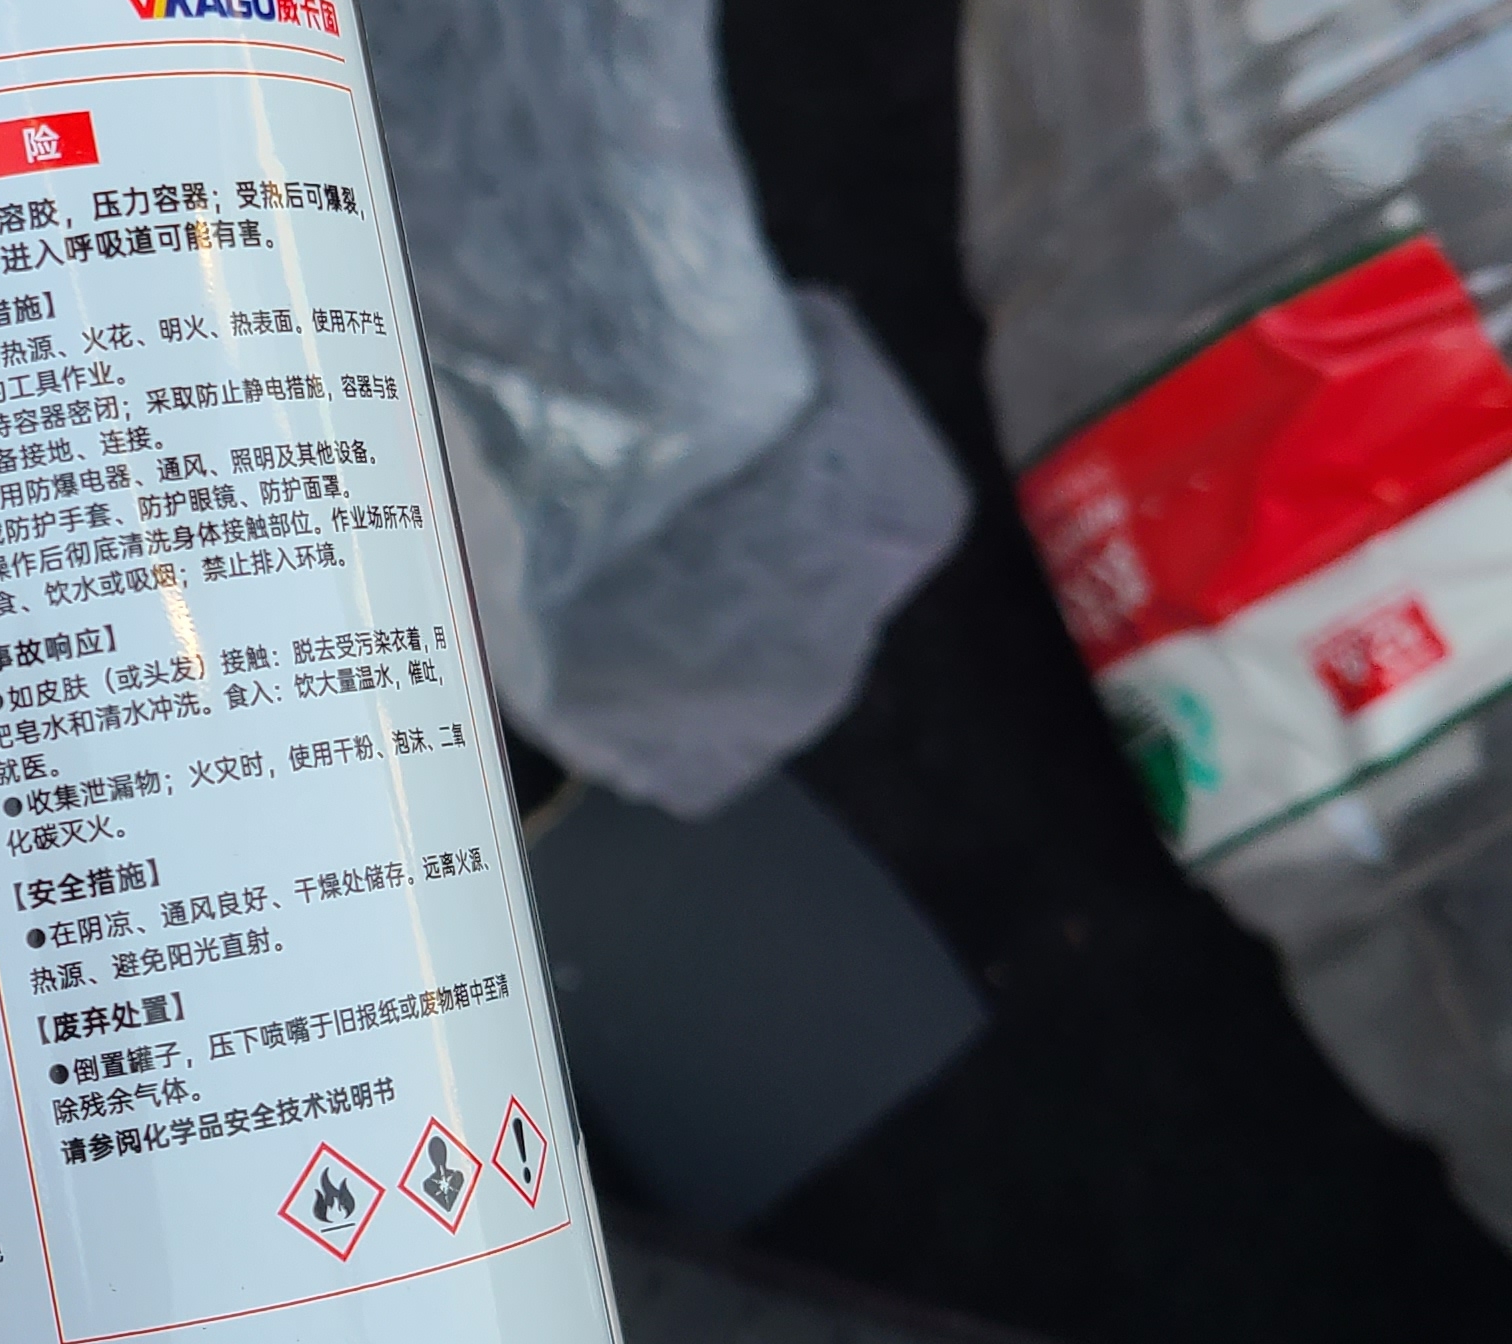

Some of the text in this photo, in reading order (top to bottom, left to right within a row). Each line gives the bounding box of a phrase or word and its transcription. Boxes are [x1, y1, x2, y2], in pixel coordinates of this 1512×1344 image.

[6, 816, 127, 857] 化碳灭火。
[14, 858, 160, 911] 【安全措施】
[29, 927, 284, 995] 热源、避免阳光直射。
[37, 992, 186, 1045] 【废弃处置】
[53, 1077, 201, 1126] 除残余气体。
[61, 1076, 396, 1165] 请参阅化学品安全技术说明书
